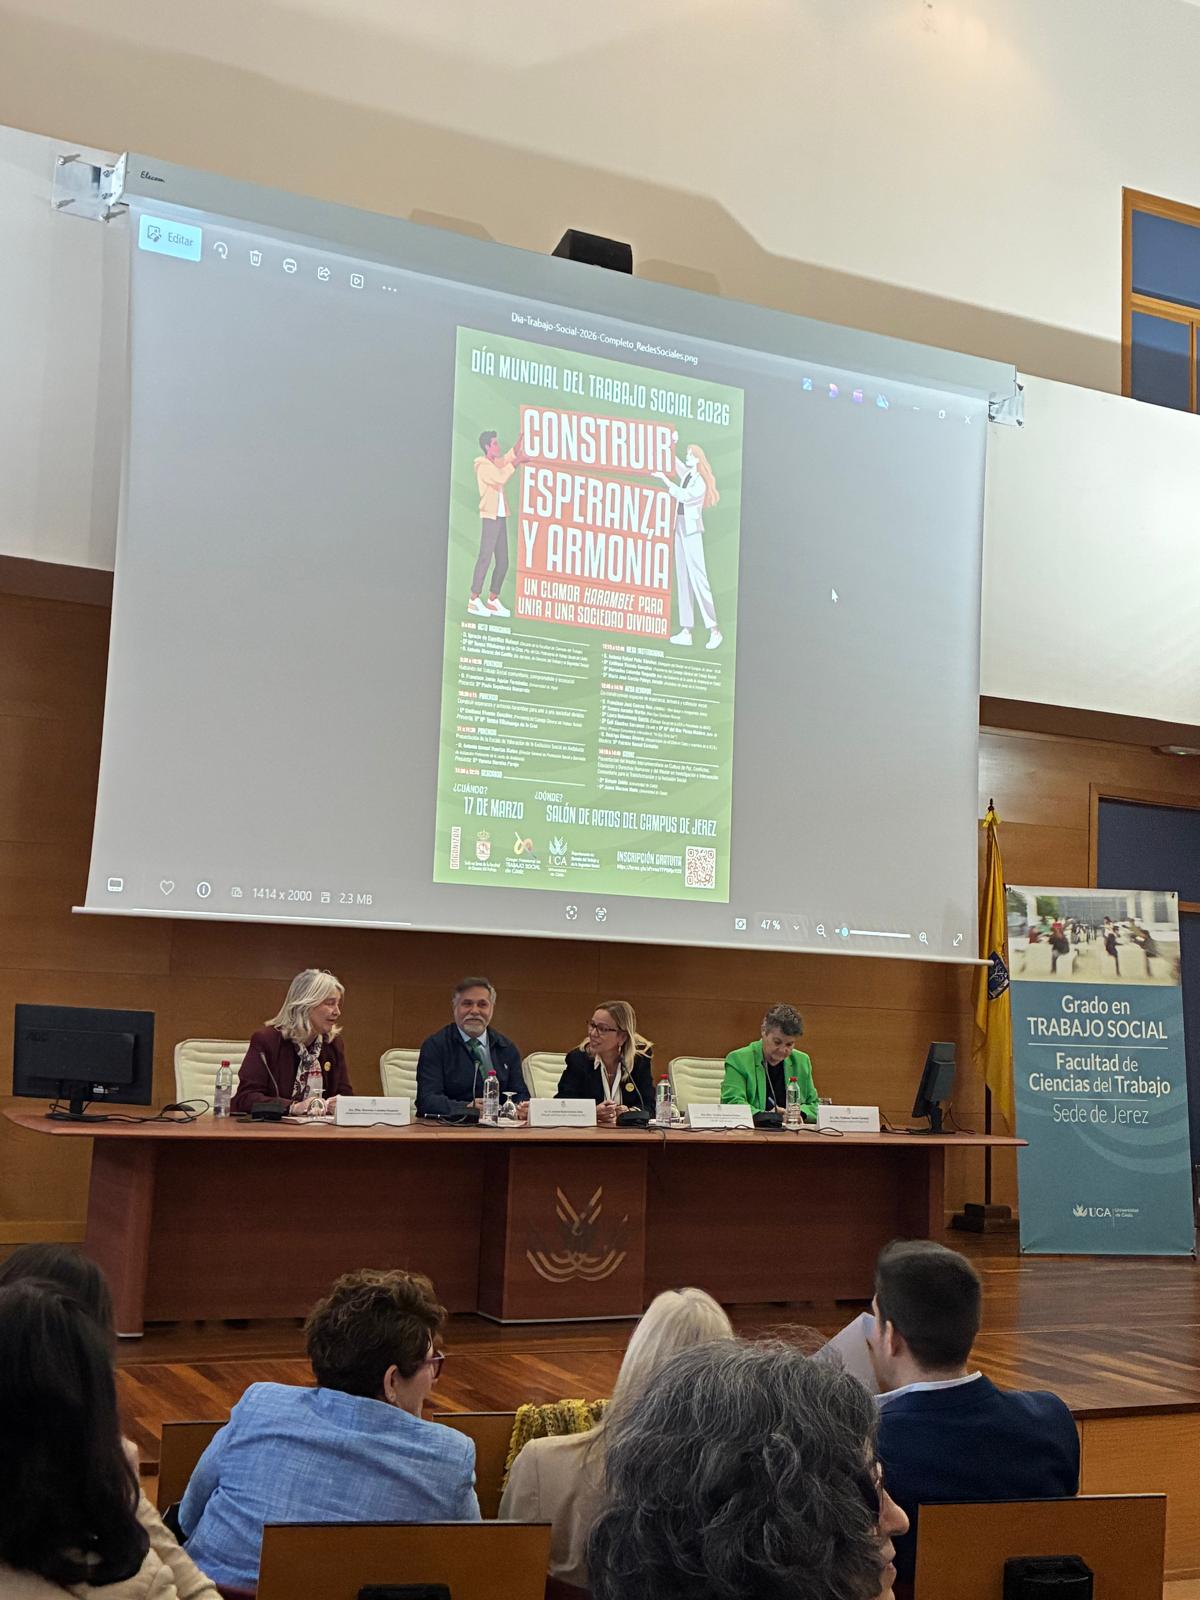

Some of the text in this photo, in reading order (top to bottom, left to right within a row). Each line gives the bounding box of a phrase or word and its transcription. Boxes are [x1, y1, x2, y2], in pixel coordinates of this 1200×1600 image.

[168, 232, 193, 246] Editar
[472, 346, 730, 426] DÍA MUNDIAL DEL TRABAJO SOCIAL 2026
[523, 408, 673, 473] CONSTRUIR
[523, 465, 671, 538] ESPERANZA
[522, 519, 670, 590] Y ARMONÍA
[524, 577, 664, 616] UN CLAMOR HARAMBEE PARA
[518, 597, 668, 636] UNIR A UNA SOCIEDAD DIVIDIDA
[464, 796, 524, 820] 17 DE MARZO
[546, 802, 717, 837] SALÓN DE ACTOS DEL CAMPUS DE JEREZ
[252, 888, 313, 902] 1414 x 2000
[339, 892, 373, 905] 2.3 MB
[761, 920, 771, 929] 47
[1062, 995, 1130, 1015] Grado en
[1027, 1017, 1168, 1040] TRABAJO SOCIAL
[1056, 1052, 1139, 1072] Facultad de
[1029, 1073, 1171, 1098] Ciencias del Trabajo
[1053, 1103, 1149, 1124] Sede de Jerez
[1089, 1207, 1112, 1217] UCA
